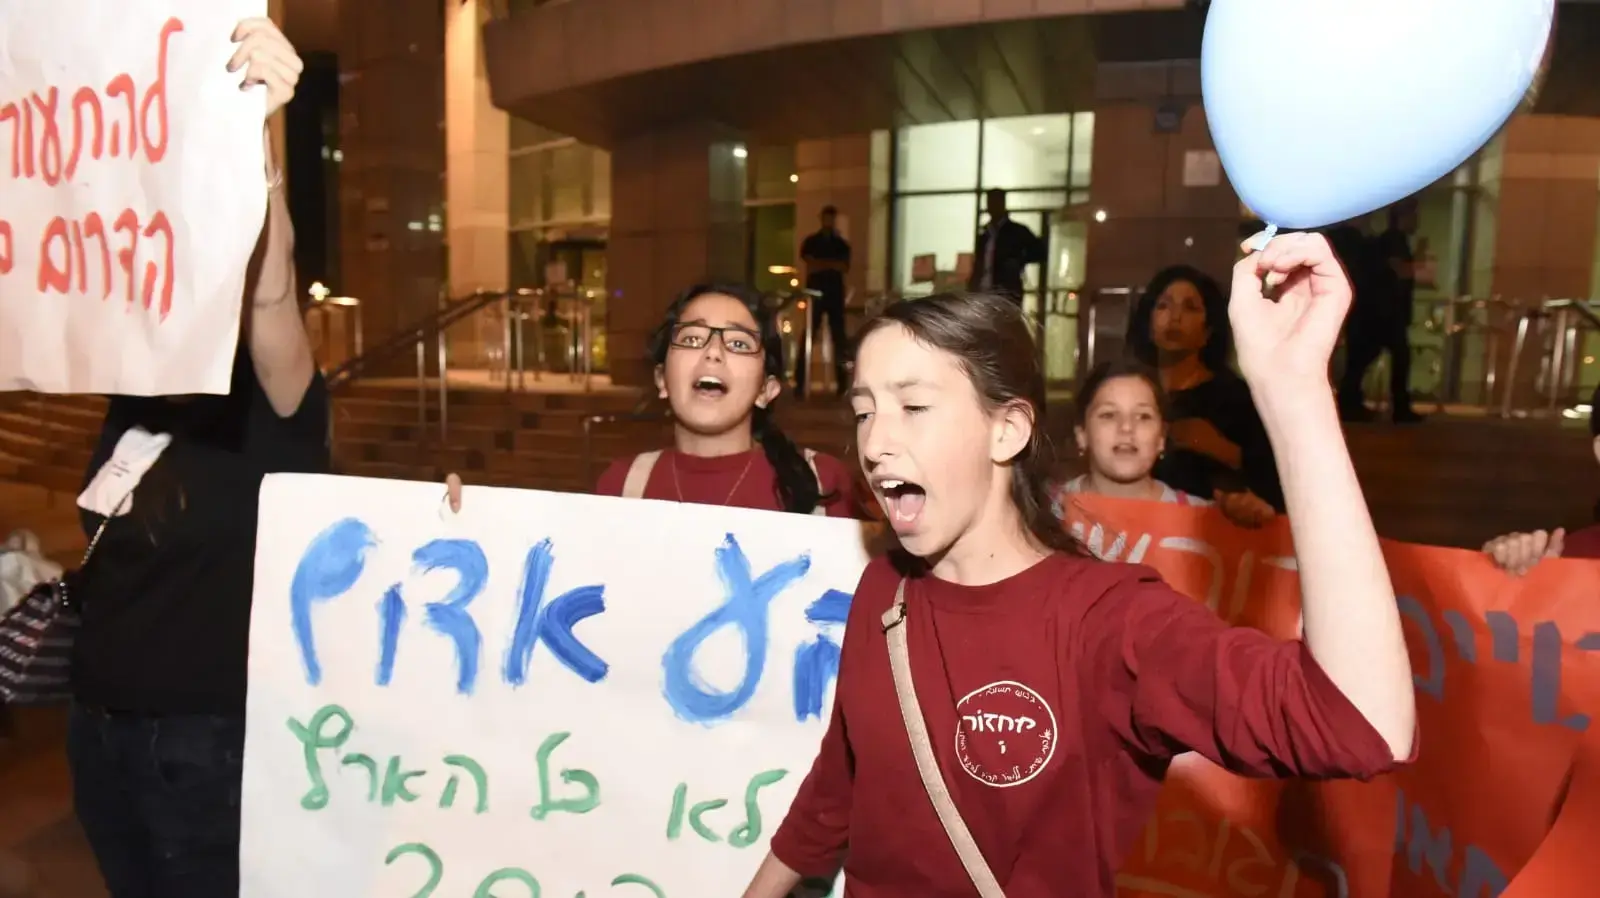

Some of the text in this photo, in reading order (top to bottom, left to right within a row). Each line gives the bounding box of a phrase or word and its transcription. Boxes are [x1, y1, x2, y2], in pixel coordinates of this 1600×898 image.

[37, 207, 174, 324] הדרום
[286, 704, 789, 849] לא כל הארץ
